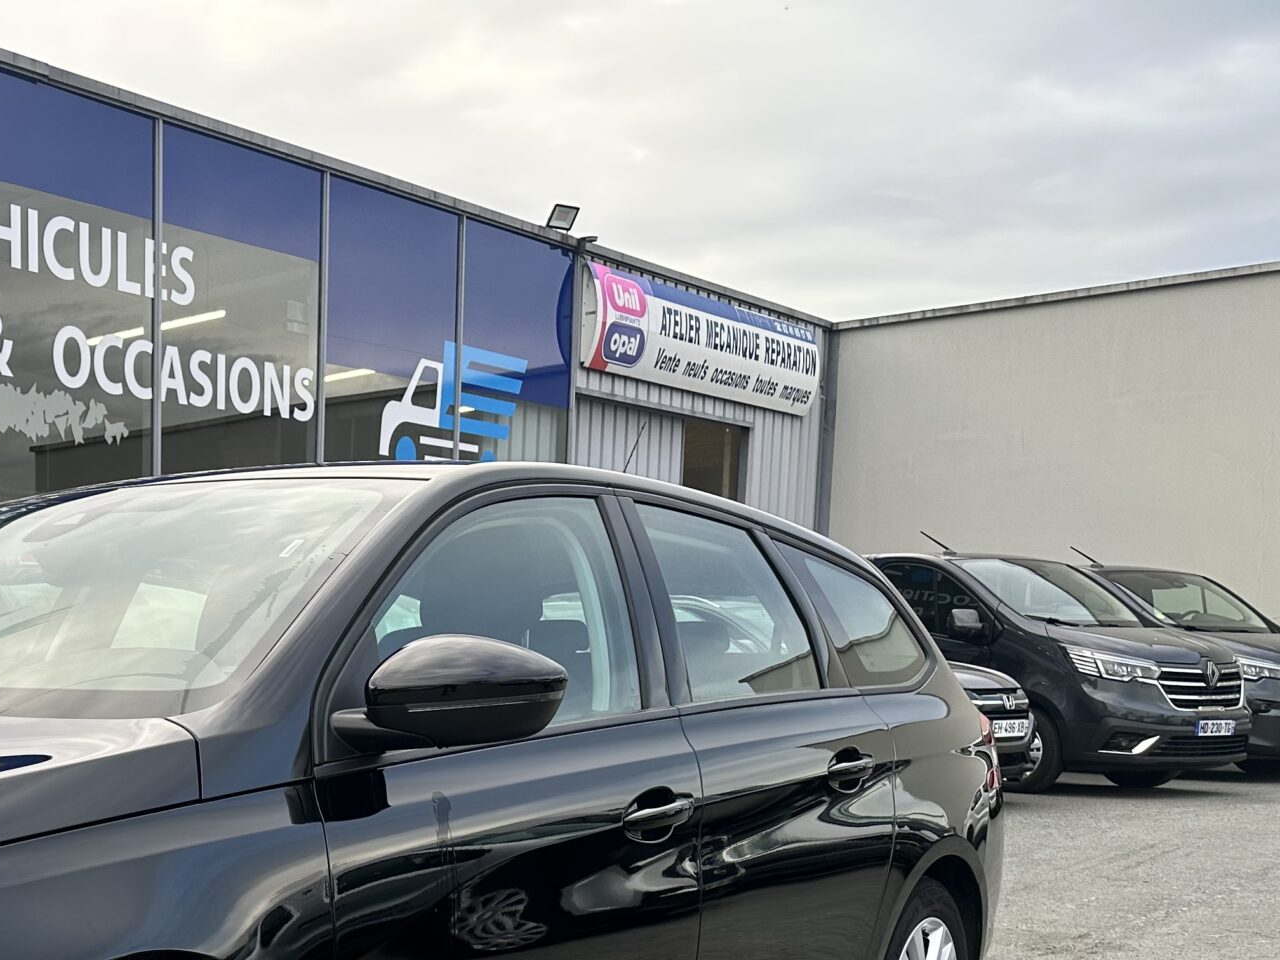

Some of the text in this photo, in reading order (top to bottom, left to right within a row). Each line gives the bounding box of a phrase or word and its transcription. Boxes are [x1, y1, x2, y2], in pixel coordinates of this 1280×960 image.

[611, 282, 641, 312] Unil
[610, 332, 641, 358] opal
[659, 305, 701, 346] ATELIER
[705, 319, 760, 362] MECANIQUE
[764, 336, 817, 377] REPARATION
[53, 325, 315, 422] OCCASIONS
[653, 347, 812, 407] Vente neufs occasions toutes marques
